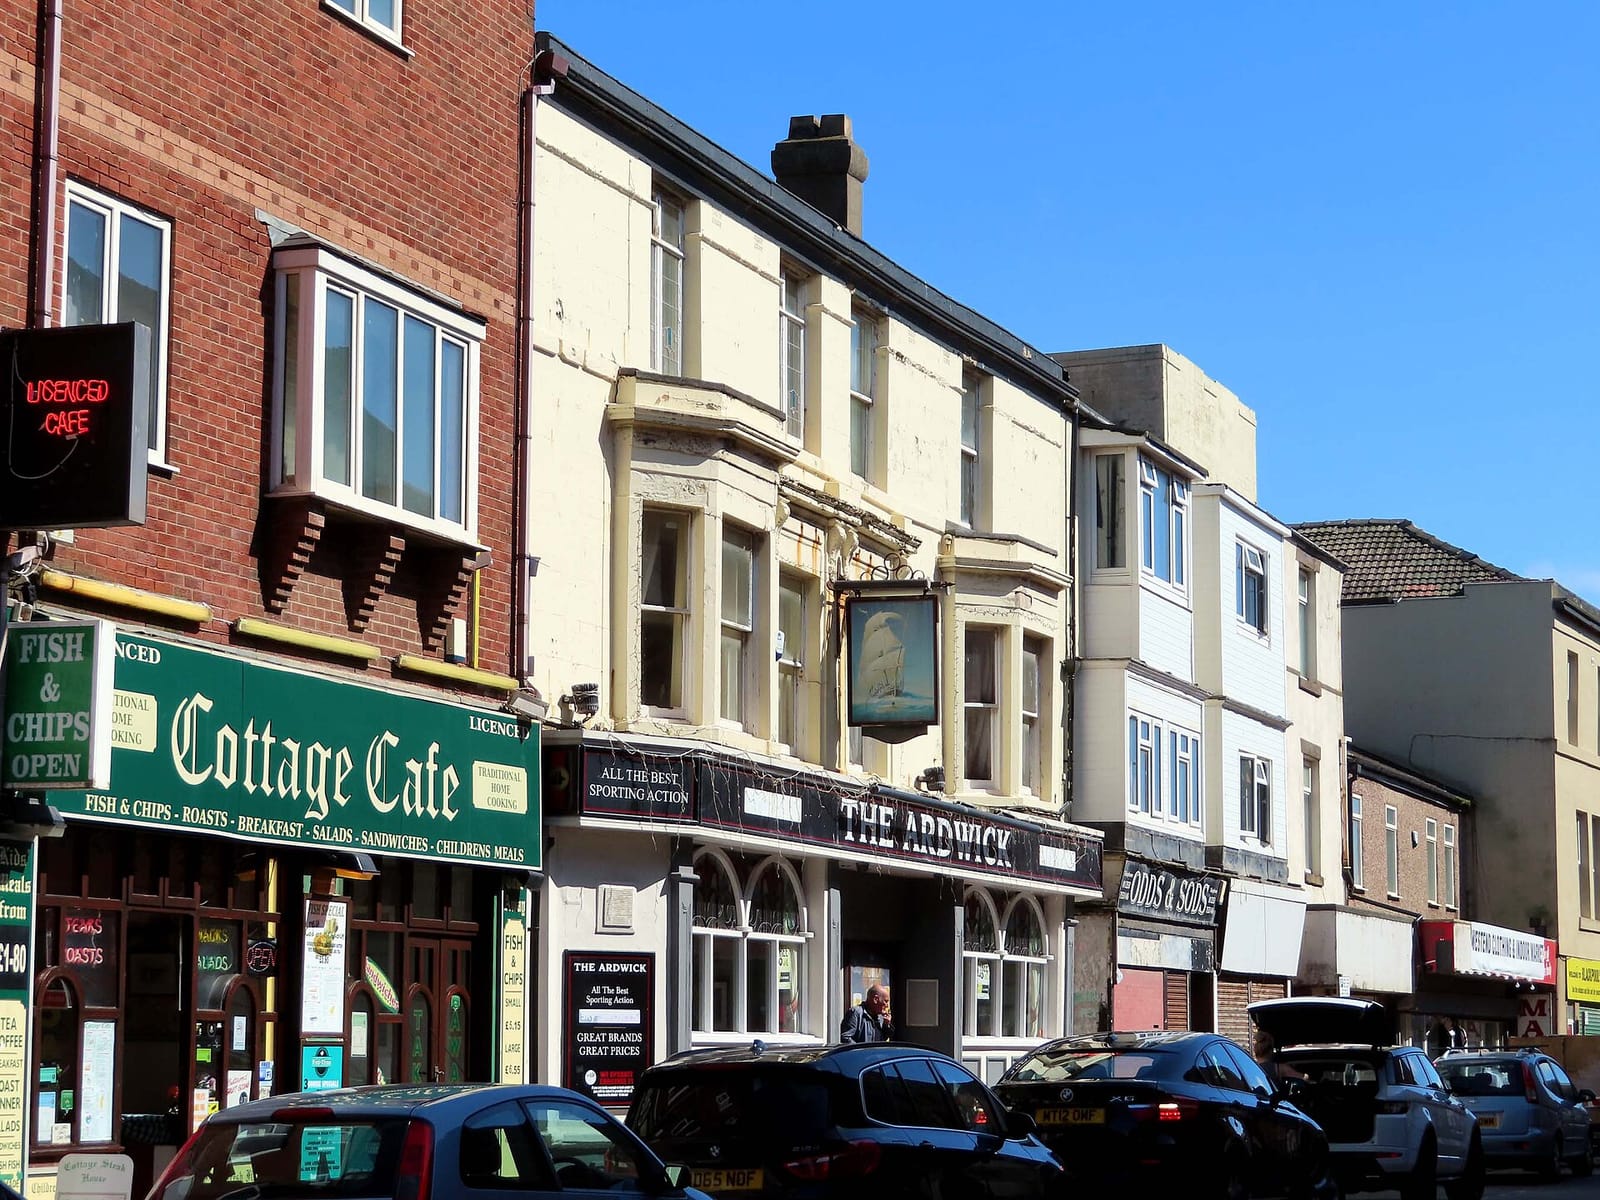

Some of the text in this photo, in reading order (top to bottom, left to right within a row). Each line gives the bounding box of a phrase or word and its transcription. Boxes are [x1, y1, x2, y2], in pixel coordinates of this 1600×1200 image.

[45, 409, 89, 435] CAFE
[19, 632, 85, 664] FISH
[39, 672, 61, 703] &
[7, 711, 90, 743] CHIPS
[469, 715, 530, 740] LICENCED
[170, 692, 460, 821] Cottage Cafe
[12, 753, 82, 778] OPEN
[478, 766, 521, 782] TRADITIONAL
[601, 767, 679, 785] ALL THE BEST
[491, 782, 511, 795] HOME
[589, 783, 689, 803] SPORTING ACTION
[487, 796, 518, 810] COOKING
[85, 794, 117, 814] FISH
[120, 798, 130, 815] &
[133, 800, 172, 821] CHIPS
[182, 806, 228, 827] ROASTS
[238, 815, 304, 839] BREAKFAST
[313, 823, 353, 843] SALADS
[361, 830, 428, 852] SANDWICHES
[436, 838, 491, 859] CHILDRENS
[494, 846, 525, 863] MEALS
[840, 799, 1012, 868] THE ARDWICK
[1130, 870, 1166, 910] ODDS
[1164, 878, 1176, 912] &
[1175, 879, 1210, 916] SODS
[0, 899, 27, 920] from
[505, 934, 523, 950] FISH
[246, 947, 276, 968] OPEN
[511, 955, 516, 968] &
[573, 962, 647, 973] THE ARDWICK
[504, 972, 523, 985] CHIPS
[591, 985, 629, 994] All The Best
[505, 998, 521, 1008] SMALL
[586, 995, 634, 1006] Sporting Action
[2, 1017, 17, 1030] TEA
[577, 1032, 643, 1043] GREAT BRANDS
[505, 1043, 521, 1053] LARGE
[579, 1046, 641, 1056] GREAT PRICES
[64, 1159, 126, 1172] Cottage Steak
[81, 1173, 107, 1183] House
